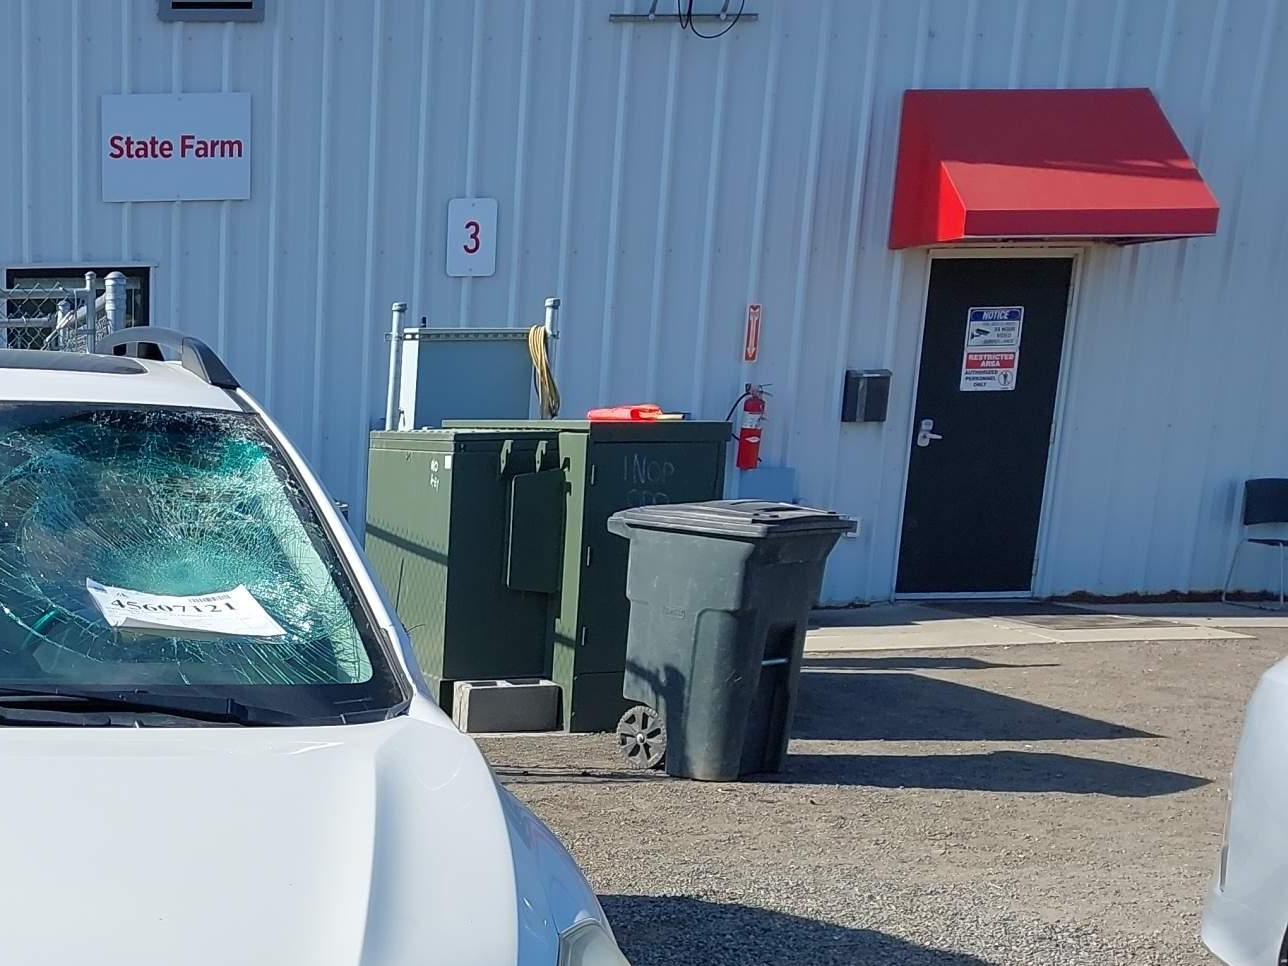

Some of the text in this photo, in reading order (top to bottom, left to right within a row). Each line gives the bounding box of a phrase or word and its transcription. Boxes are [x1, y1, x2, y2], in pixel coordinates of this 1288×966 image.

[109, 135, 243, 159] State Farm
[463, 221, 480, 254] 3
[982, 310, 1011, 320] NOTICE
[111, 599, 238, 614] 45607121
